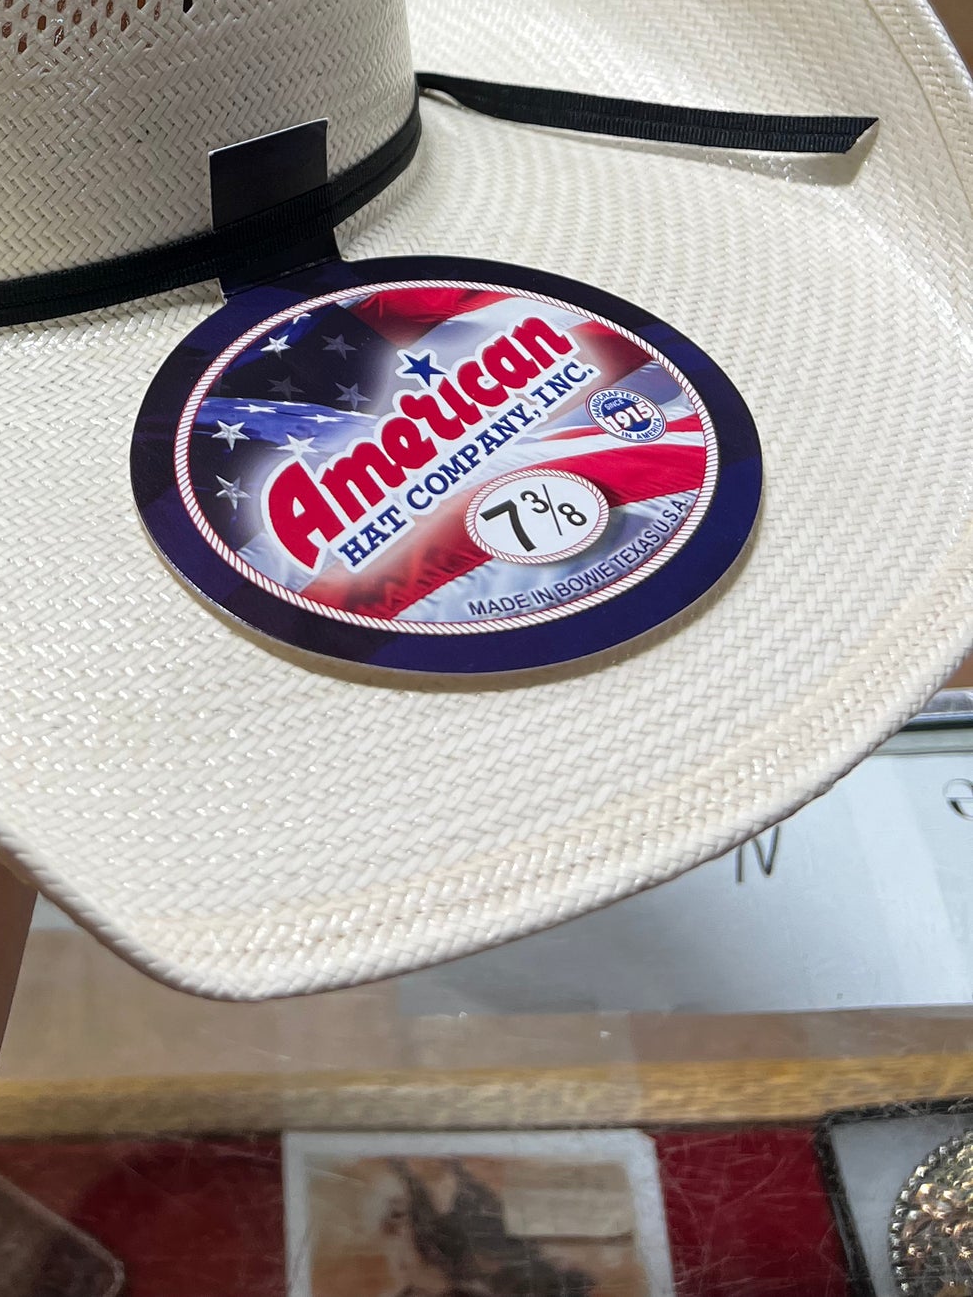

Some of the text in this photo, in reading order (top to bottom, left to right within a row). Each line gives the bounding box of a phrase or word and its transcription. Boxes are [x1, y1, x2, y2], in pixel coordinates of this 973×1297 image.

[591, 390, 640, 418] HANDCRAFTED
[604, 398, 625, 411] SINCE
[604, 402, 654, 432] 1915
[268, 316, 573, 569] American
[621, 417, 663, 440] IN AMERICA
[337, 362, 594, 567] HAT COMPANY, INC.
[468, 498, 690, 616] MADE IN BOWIE TEXAS U.S.A.
